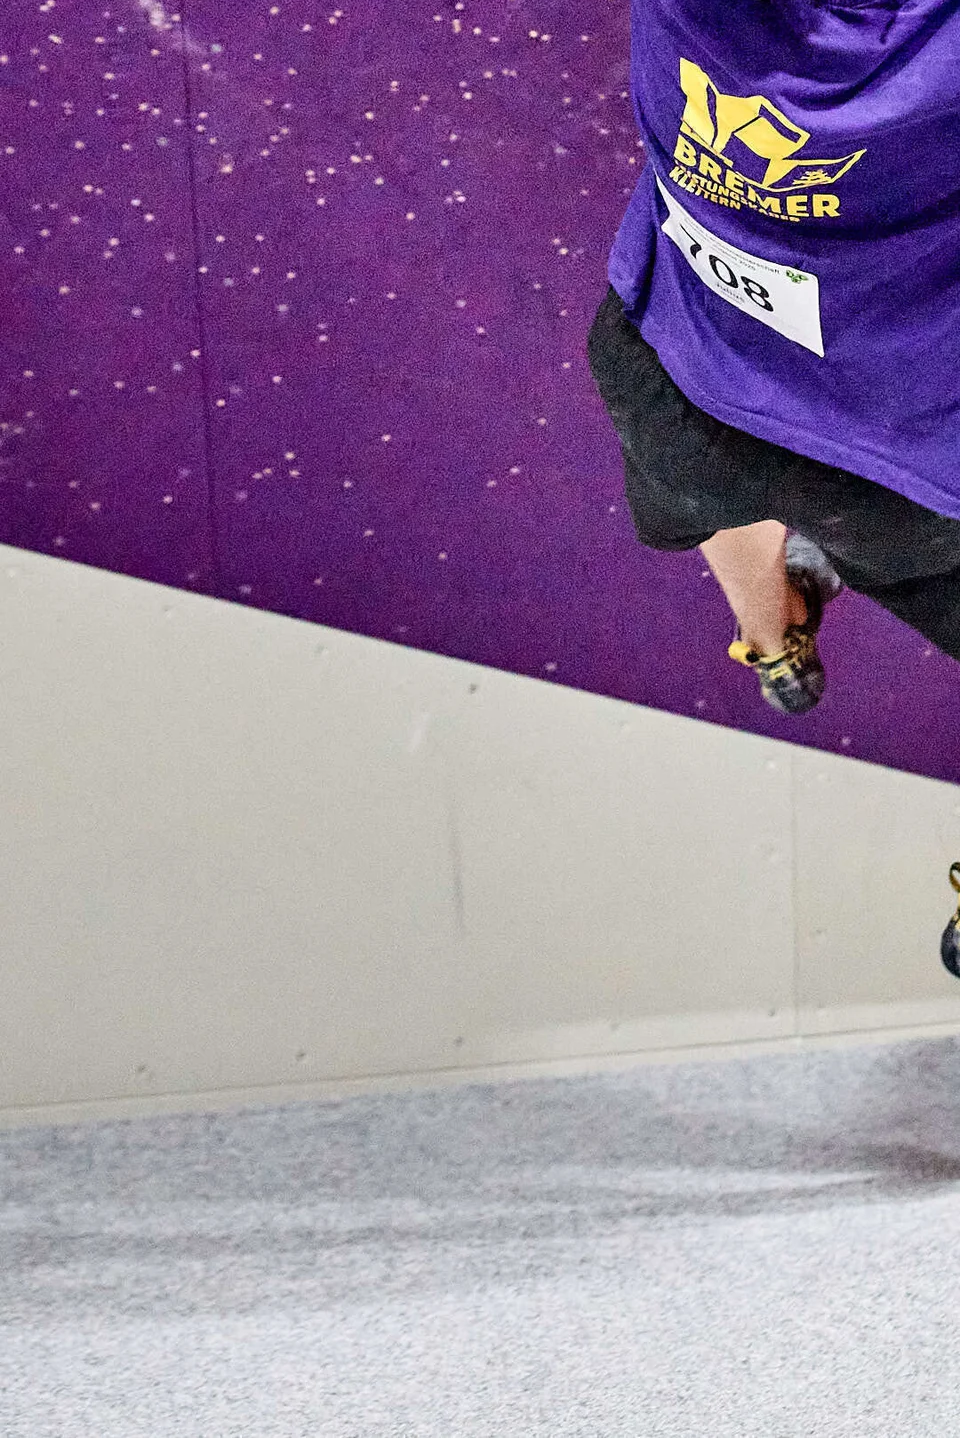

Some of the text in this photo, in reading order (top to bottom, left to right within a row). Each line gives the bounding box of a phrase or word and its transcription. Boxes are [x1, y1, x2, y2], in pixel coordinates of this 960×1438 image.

[669, 166, 742, 211] KLETTERN
[673, 134, 841, 218] BREMER
[679, 223, 775, 312] 708
